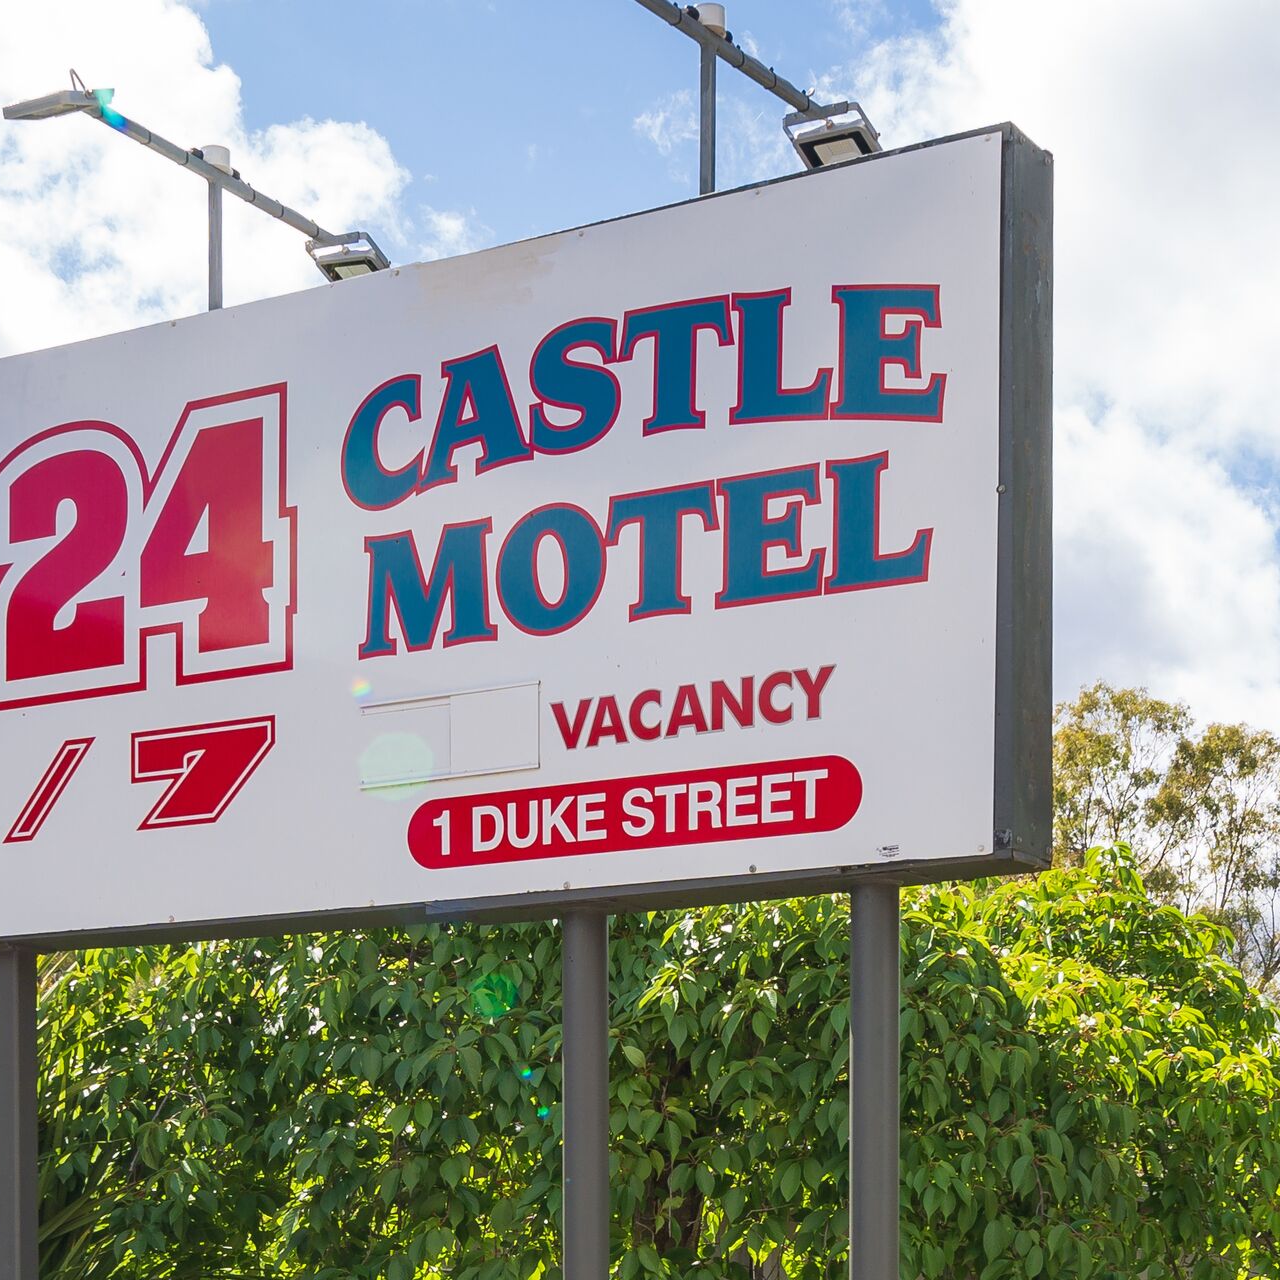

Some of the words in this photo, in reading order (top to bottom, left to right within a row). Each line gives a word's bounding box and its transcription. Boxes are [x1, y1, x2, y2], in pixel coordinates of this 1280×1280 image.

[341, 284, 947, 511] CASTLE
[358, 451, 934, 661] MOTEL
[550, 664, 836, 750] VACANCY
[431, 810, 451, 856] 1
[472, 792, 607, 852] DUKE
[622, 768, 829, 837] STREET
